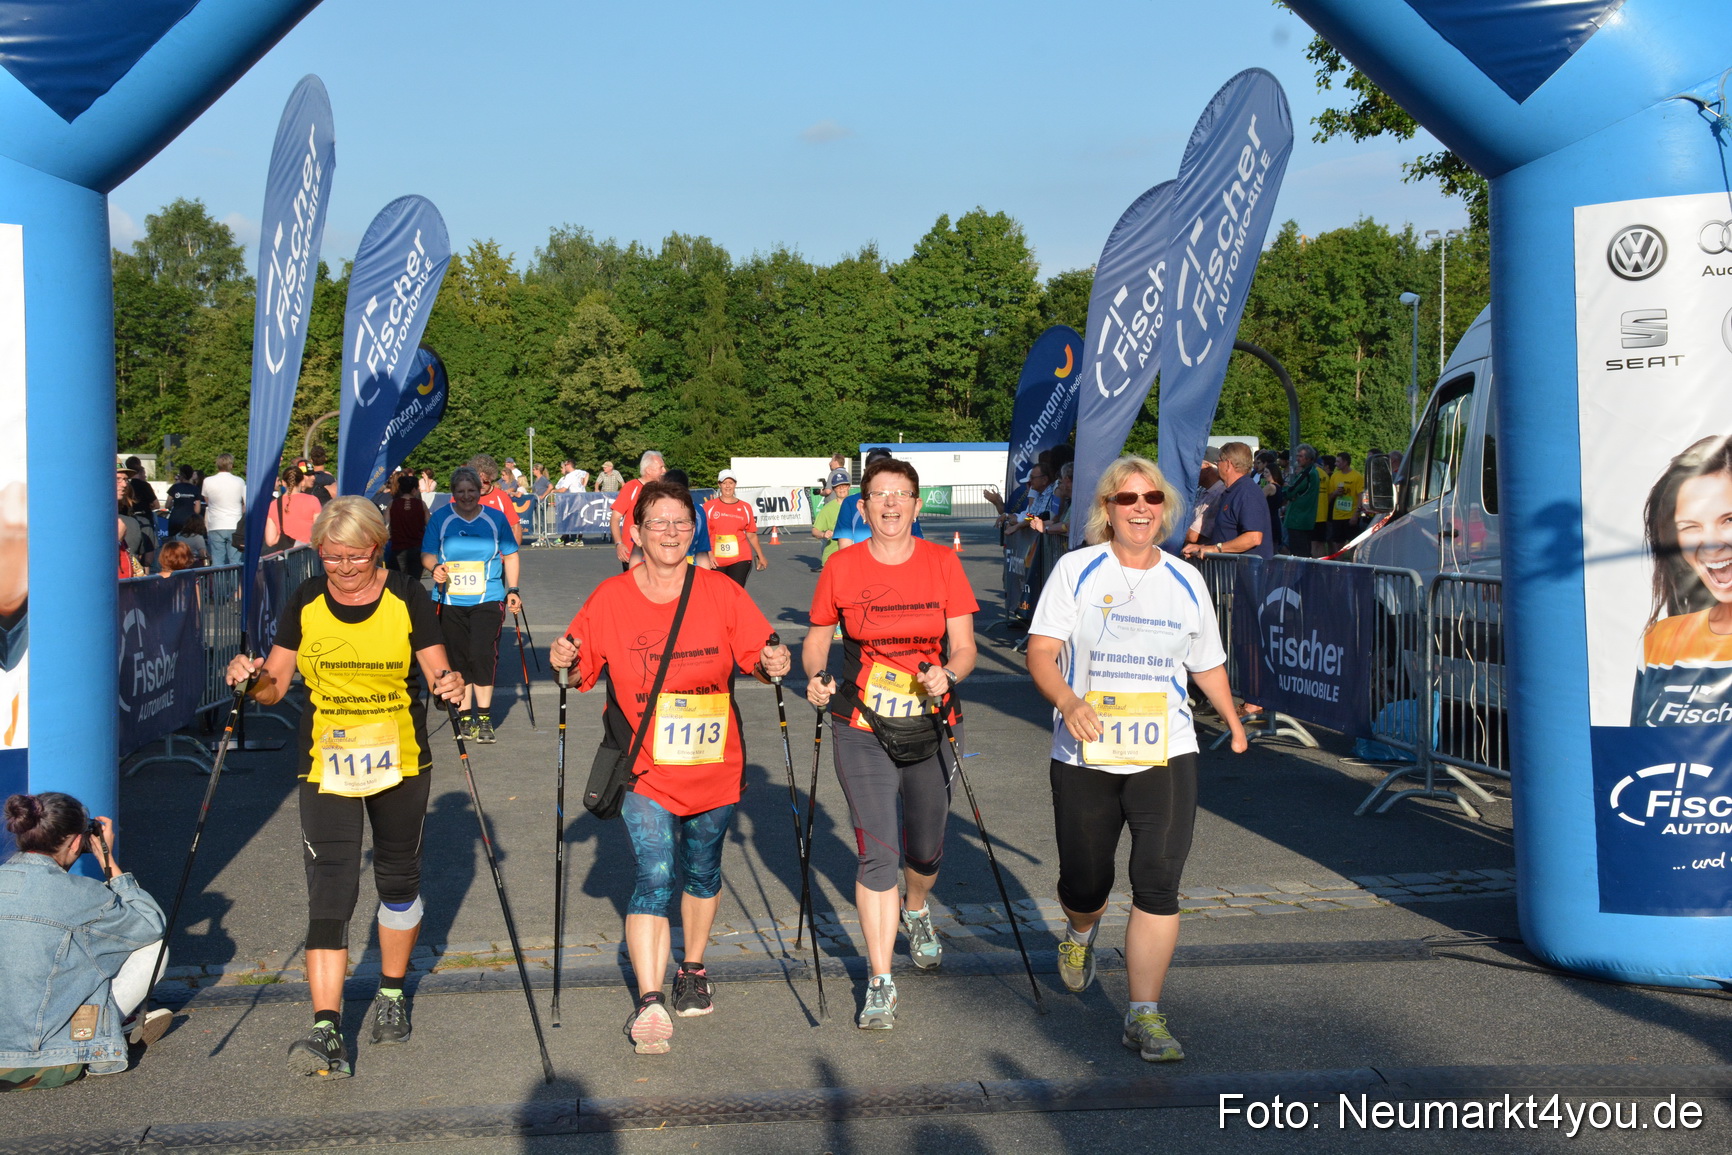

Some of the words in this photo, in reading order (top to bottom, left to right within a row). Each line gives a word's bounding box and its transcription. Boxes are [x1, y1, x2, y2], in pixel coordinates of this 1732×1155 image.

[276, 123, 317, 340] Fischer
[1192, 113, 1261, 331] Fischer
[290, 161, 321, 337] AUTOMOBILE
[1216, 149, 1270, 326] AUTOMOBILE
[366, 229, 425, 382] Fischer
[386, 257, 433, 379] AUTOMOBILE
[1138, 305, 1164, 369] AUTO
[1606, 355, 1685, 371] SEAT
[1013, 382, 1066, 472] Frischmann
[1051, 409, 1065, 430] Druck
[756, 496, 790, 514] swn
[926, 490, 949, 504] AOK
[453, 575, 477, 586] 519
[871, 602, 925, 613] Physiotherapie
[1111, 612, 1167, 627] Physiotherapie
[1167, 619, 1182, 630] Wild
[704, 646, 719, 655] Wild
[871, 637, 911, 647] machen
[913, 636, 928, 644] Sie
[1270, 625, 1344, 676] Fischer
[320, 661, 385, 670] Physiotherapie
[386, 660, 404, 669] Wild
[1090, 650, 1106, 662] Wir
[1107, 652, 1146, 665] machen
[1147, 655, 1164, 668] Sie
[1279, 674, 1340, 703] AUTOMOBILE
[664, 722, 721, 745] 1113
[1099, 720, 1160, 745] 1110
[328, 750, 393, 776] 1114
[1692, 851, 1726, 870] und
